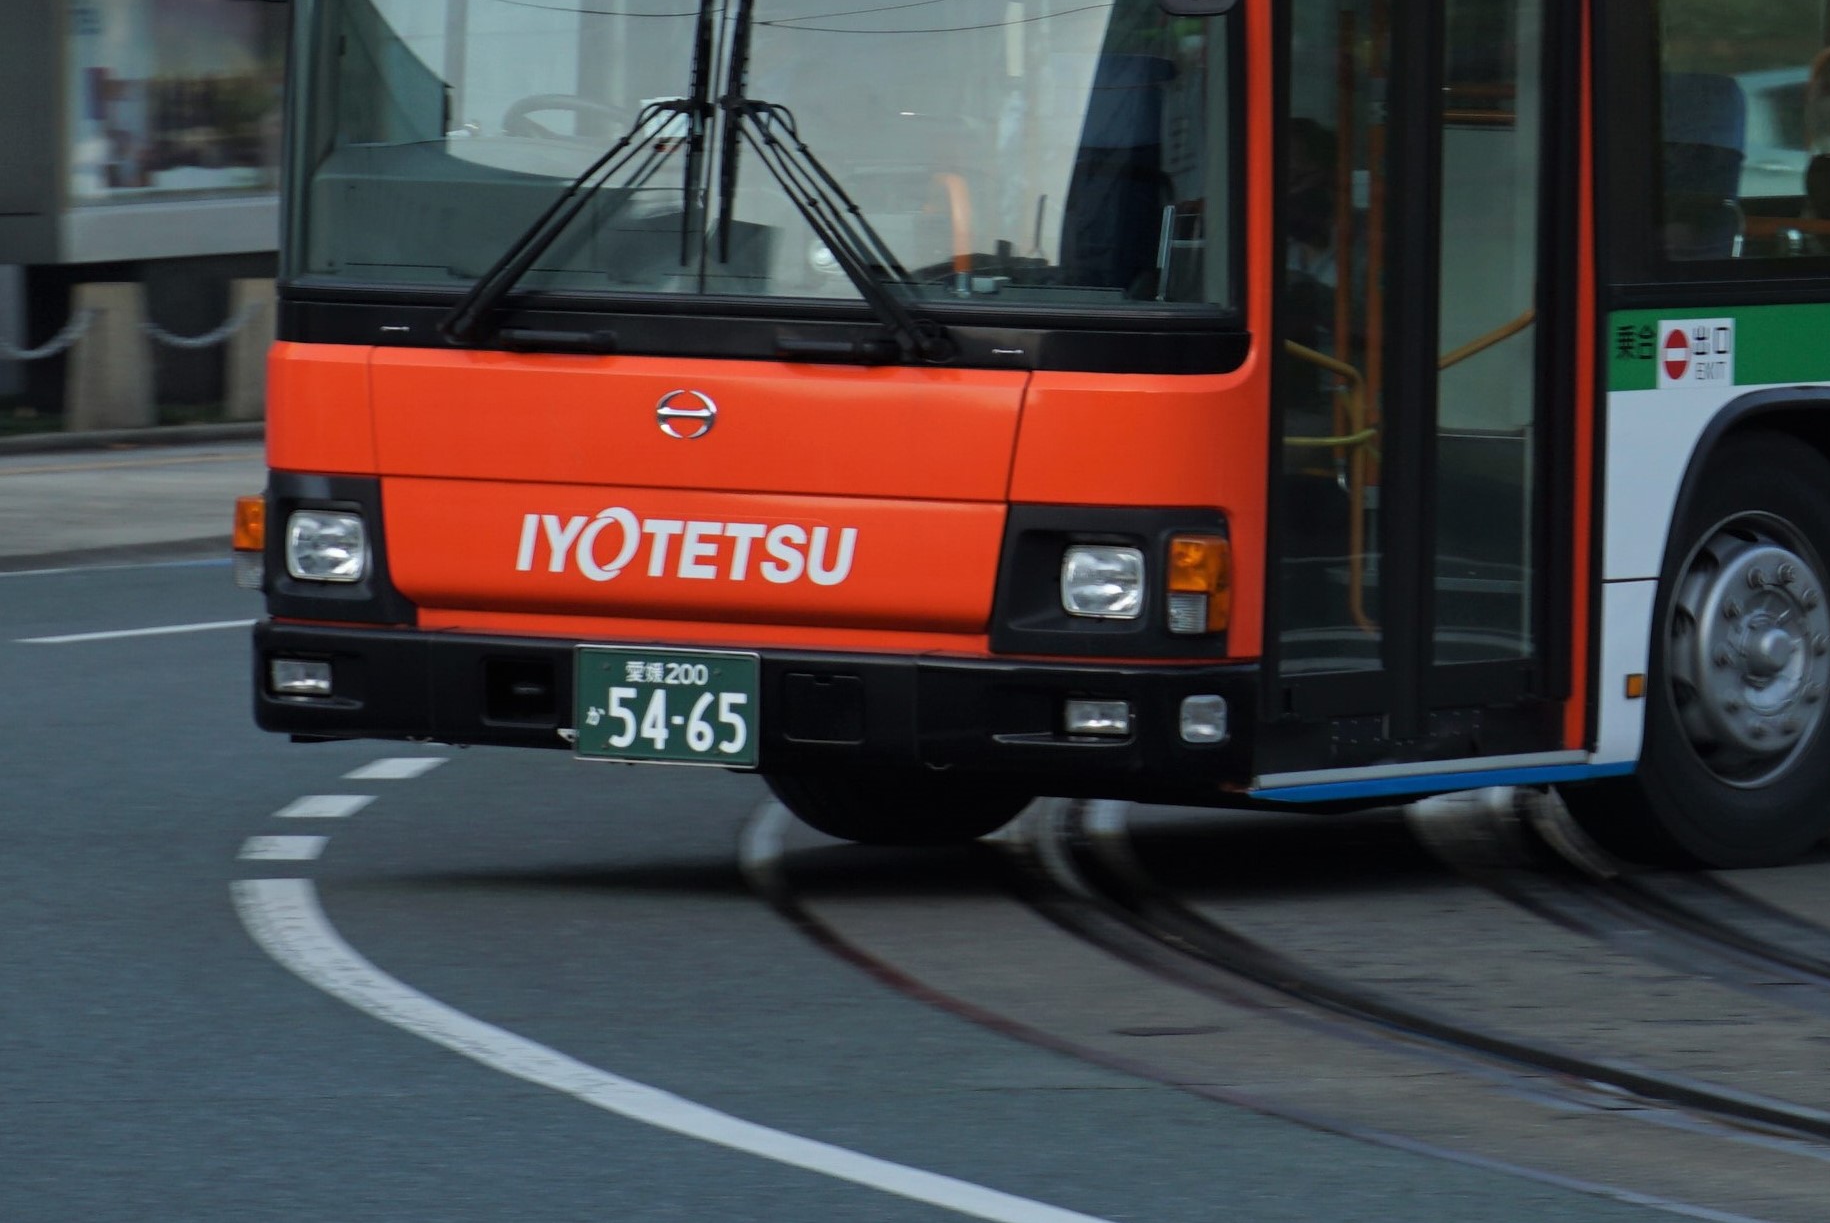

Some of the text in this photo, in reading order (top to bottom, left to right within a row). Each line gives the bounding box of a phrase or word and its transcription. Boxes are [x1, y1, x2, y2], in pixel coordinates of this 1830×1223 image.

[1692, 326, 1731, 355] 出口
[515, 506, 858, 586] IYOTETSU
[608, 686, 748, 754] 54-65
